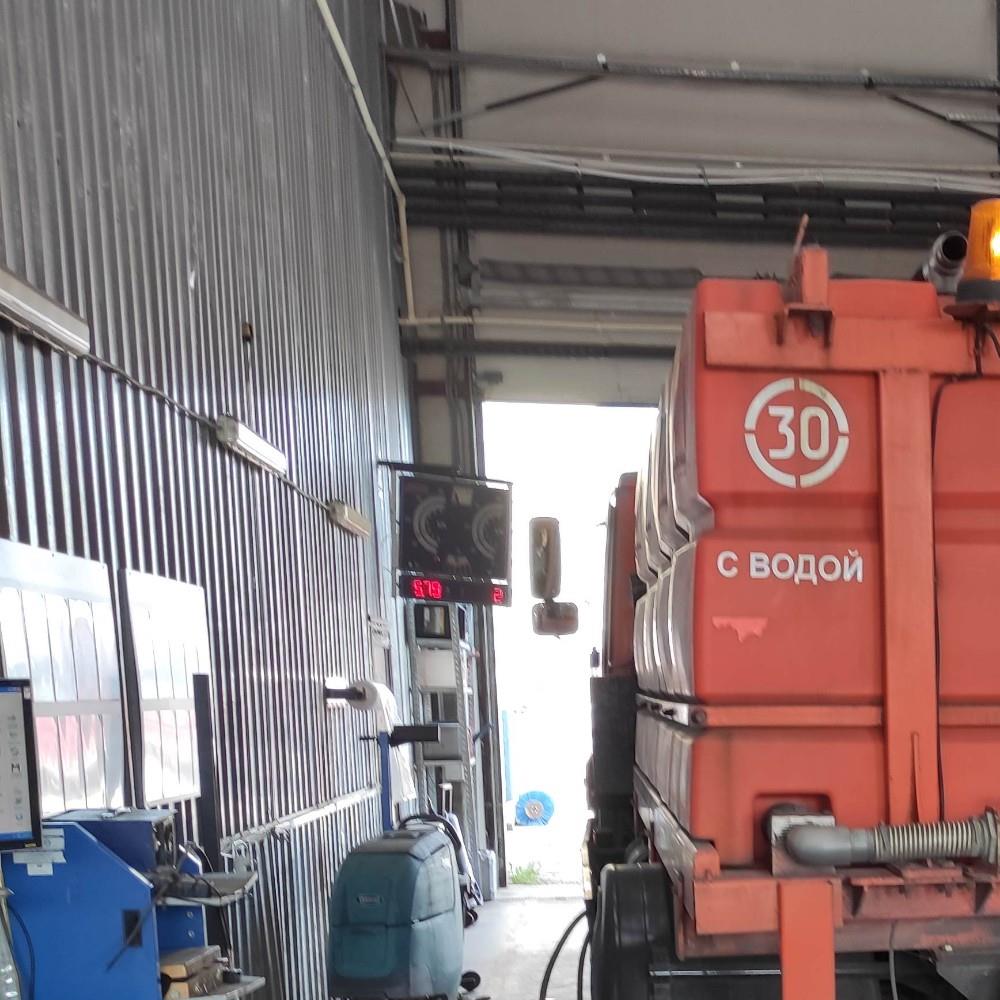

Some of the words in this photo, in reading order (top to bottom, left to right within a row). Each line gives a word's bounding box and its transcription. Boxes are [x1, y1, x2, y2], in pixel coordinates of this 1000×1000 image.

[768, 405, 830, 461] 30
[716, 550, 738, 578] С
[749, 549, 863, 585] ВОДОЙ
